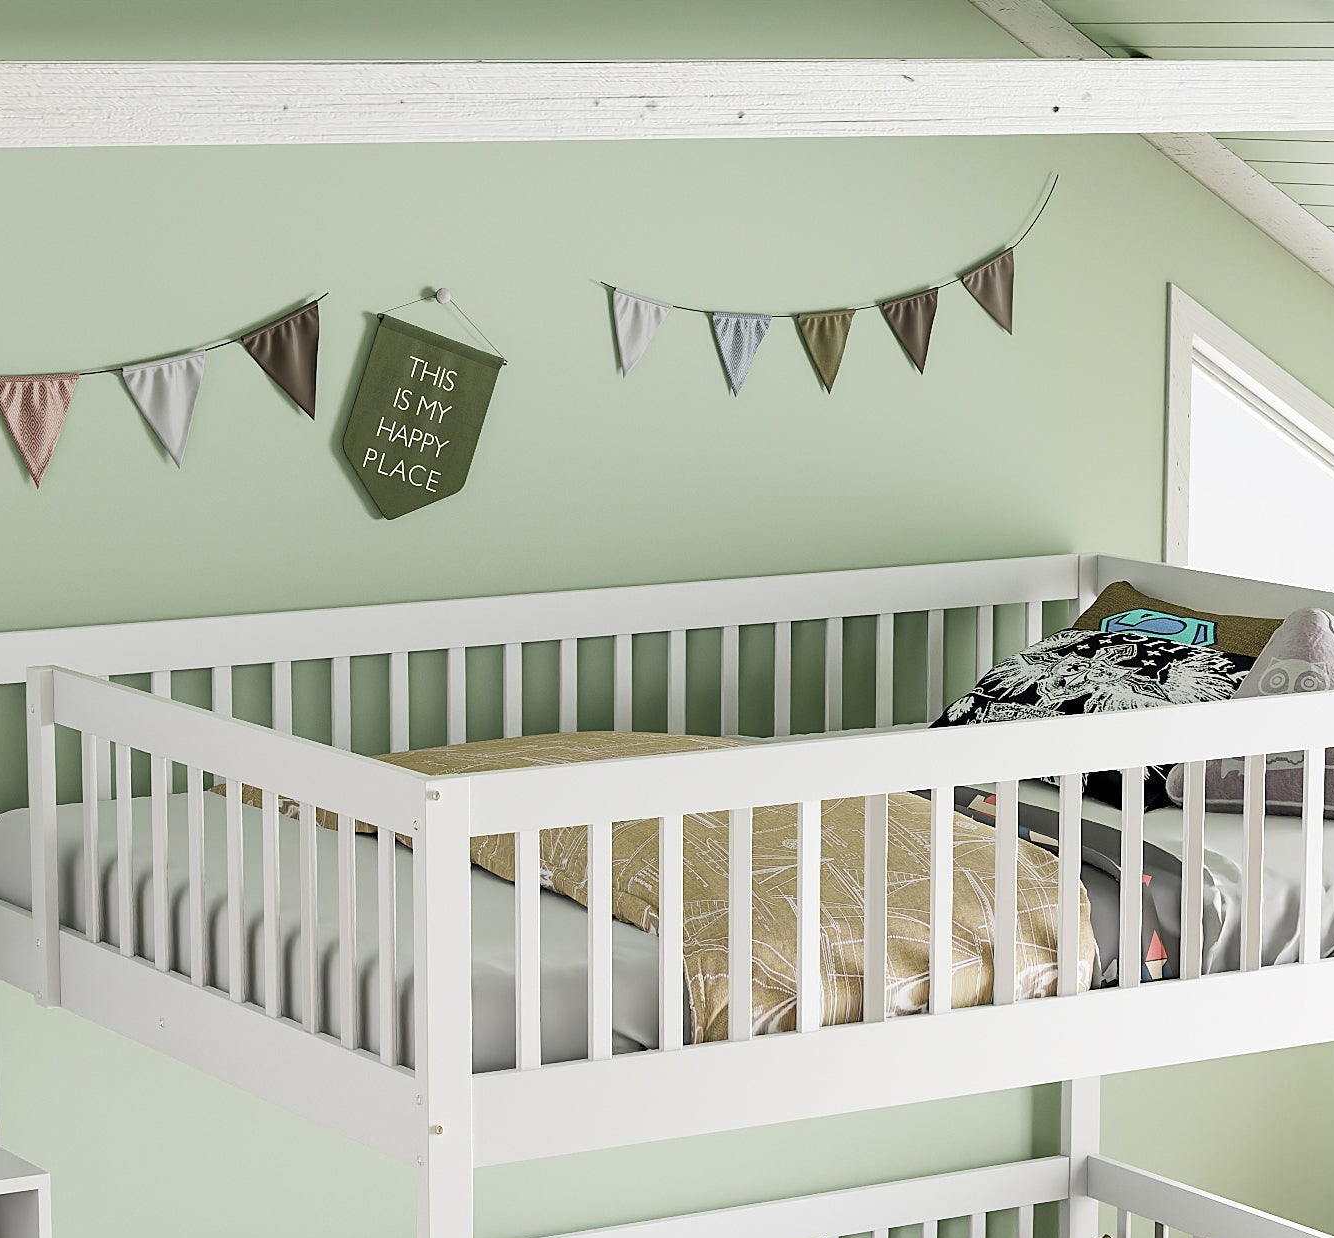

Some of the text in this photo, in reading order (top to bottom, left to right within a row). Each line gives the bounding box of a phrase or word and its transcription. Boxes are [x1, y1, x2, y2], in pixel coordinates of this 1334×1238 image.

[409, 355, 458, 392] THIS
[392, 387, 453, 424] IS MY
[376, 416, 450, 458] HAPPY
[362, 447, 442, 493] PLACE
